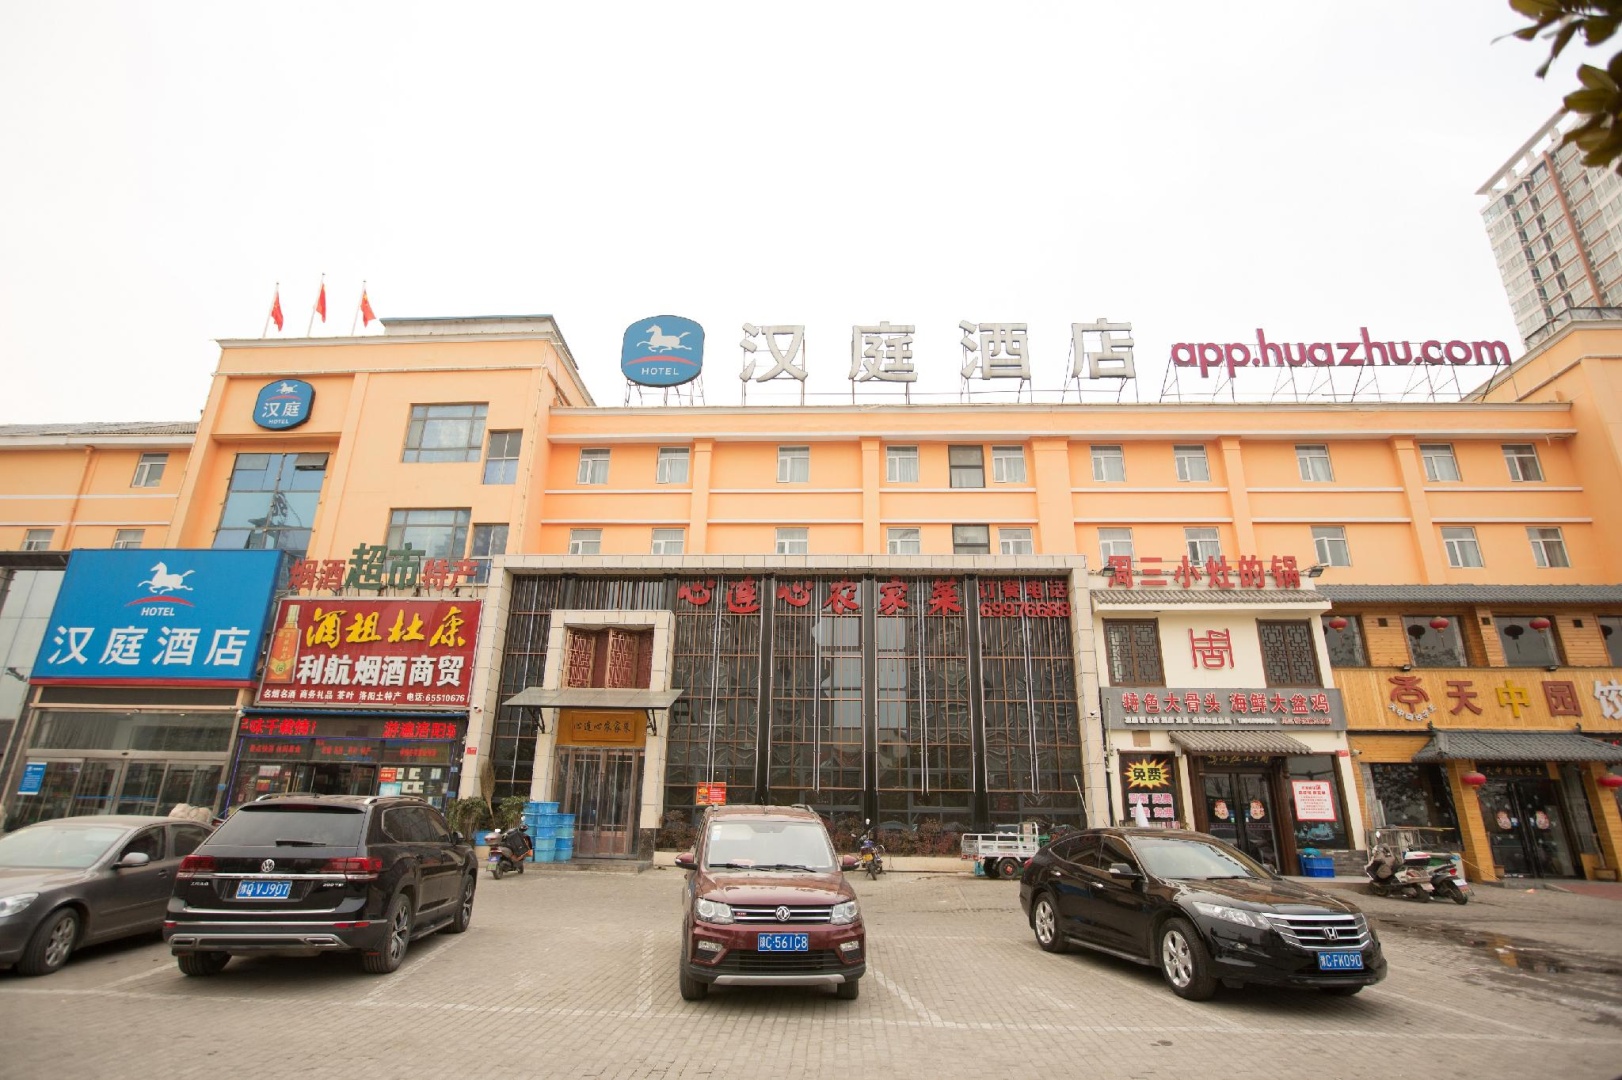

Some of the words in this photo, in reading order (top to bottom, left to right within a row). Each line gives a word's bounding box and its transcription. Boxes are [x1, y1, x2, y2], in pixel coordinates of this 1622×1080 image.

[739, 318, 1137, 384] 汉庭酒店
[1171, 327, 1512, 378] app.huazhu.com
[641, 366, 680, 376] HOTEL
[262, 401, 301, 418] 汉庭
[1107, 554, 1301, 589] 周三小灶的锅
[678, 574, 962, 616] 心连心农家菜
[978, 579, 1069, 600] 订餐电话
[140, 606, 175, 617] HOTEL
[980, 601, 1072, 618] 69976688
[306, 605, 467, 650] 酒祖杜康
[47, 625, 251, 666] 汉庭酒店
[296, 653, 465, 687] 利航烟酒商贸
[1122, 691, 1222, 714] 特色大骨头
[1229, 692, 1331, 715] 海鲜大盆鸡
[1132, 767, 1162, 781] 免费
